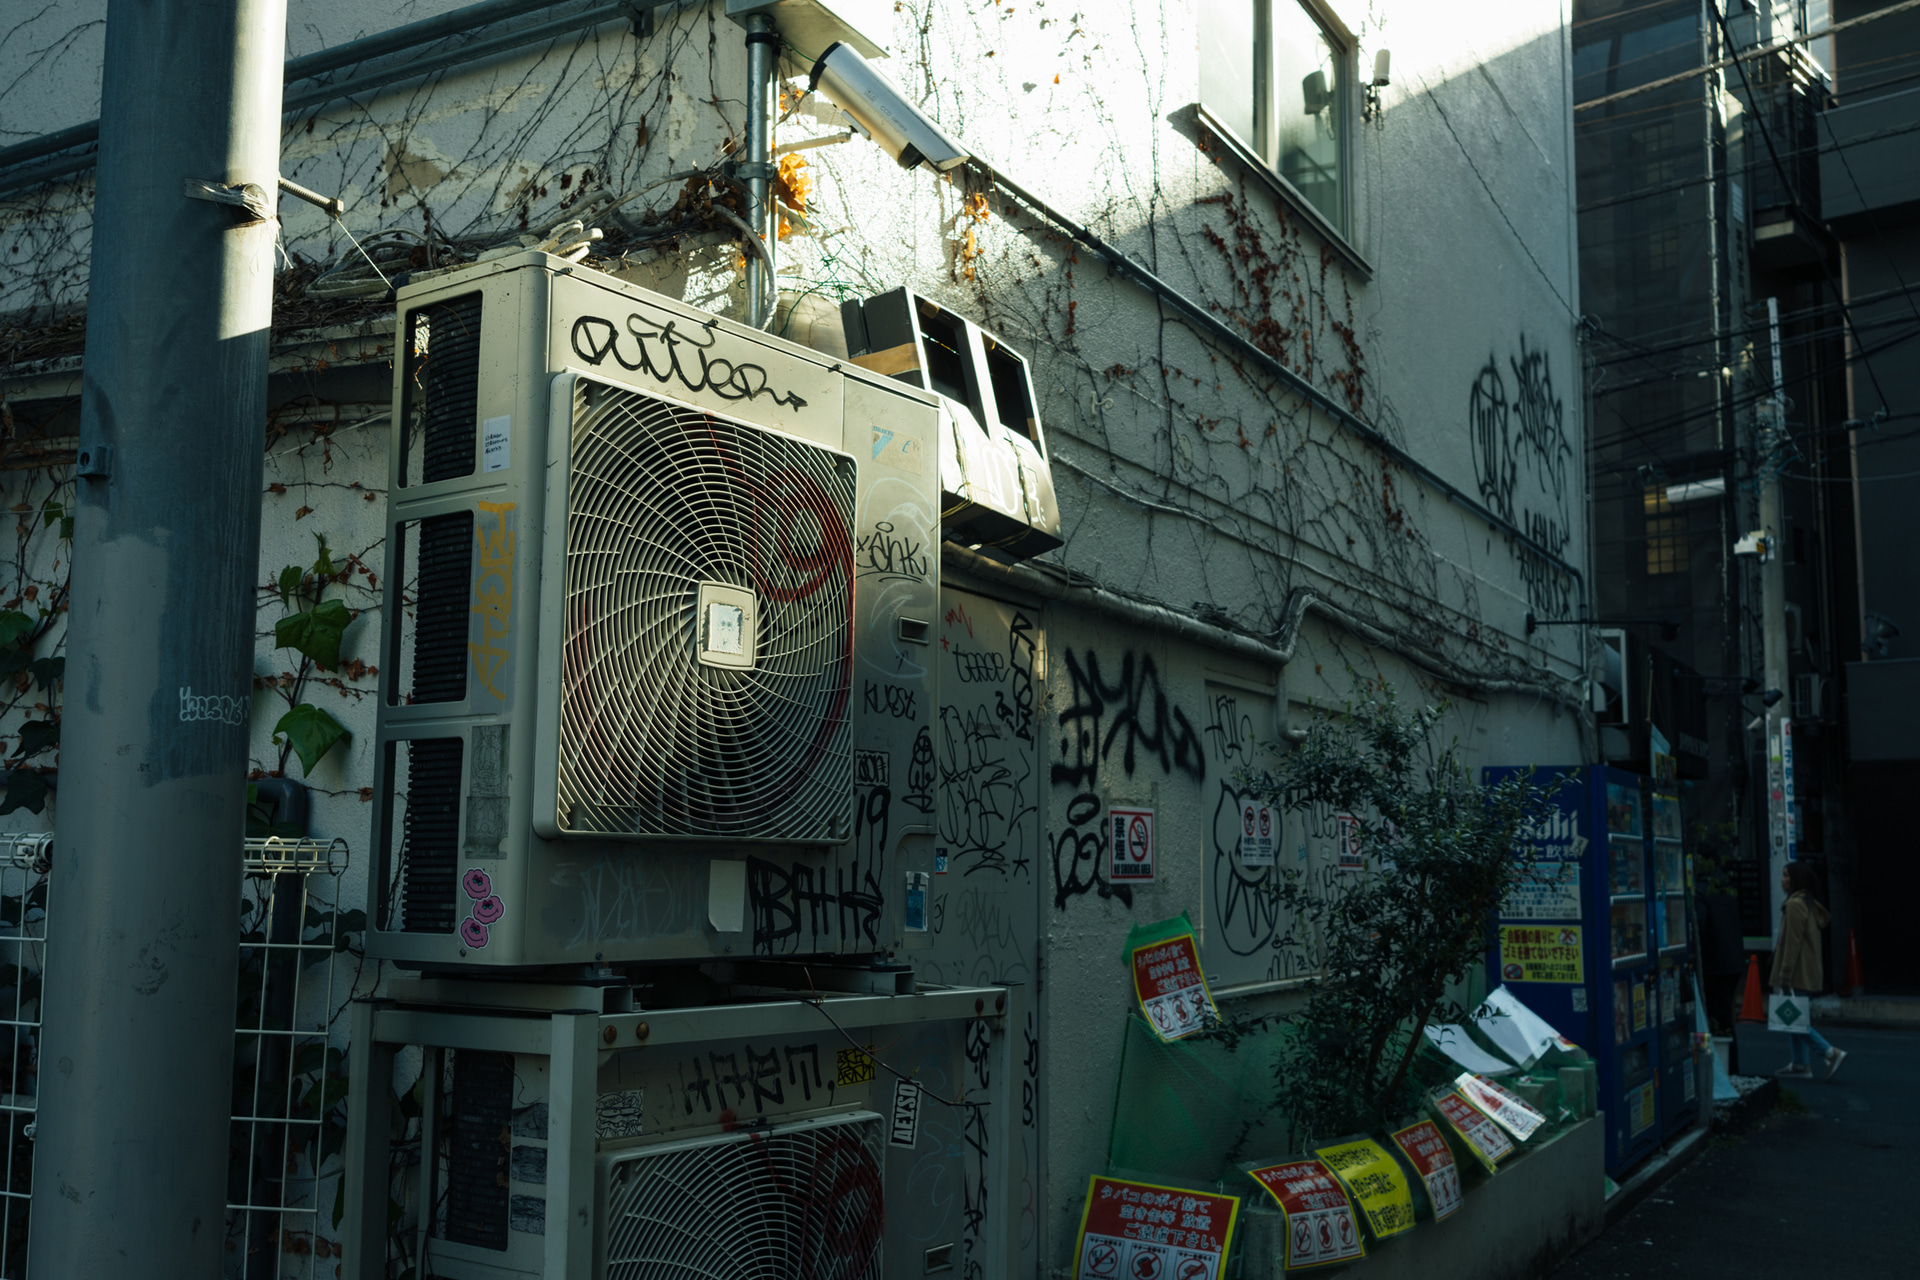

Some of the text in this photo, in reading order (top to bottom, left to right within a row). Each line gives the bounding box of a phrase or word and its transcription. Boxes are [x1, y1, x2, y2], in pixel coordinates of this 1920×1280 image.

[880, 105, 892, 117] CCD
[1511, 808, 1578, 841] sahi
[1115, 816, 1125, 861] 禁煙
[1114, 864, 1151, 875] NO SMOKING AREA
[1504, 945, 1579, 961] ゴミを捨てないで下さい
[1101, 1184, 1212, 1214] タバコのポイ捨て
[1118, 1204, 1212, 1231] 空き缶等 放置
